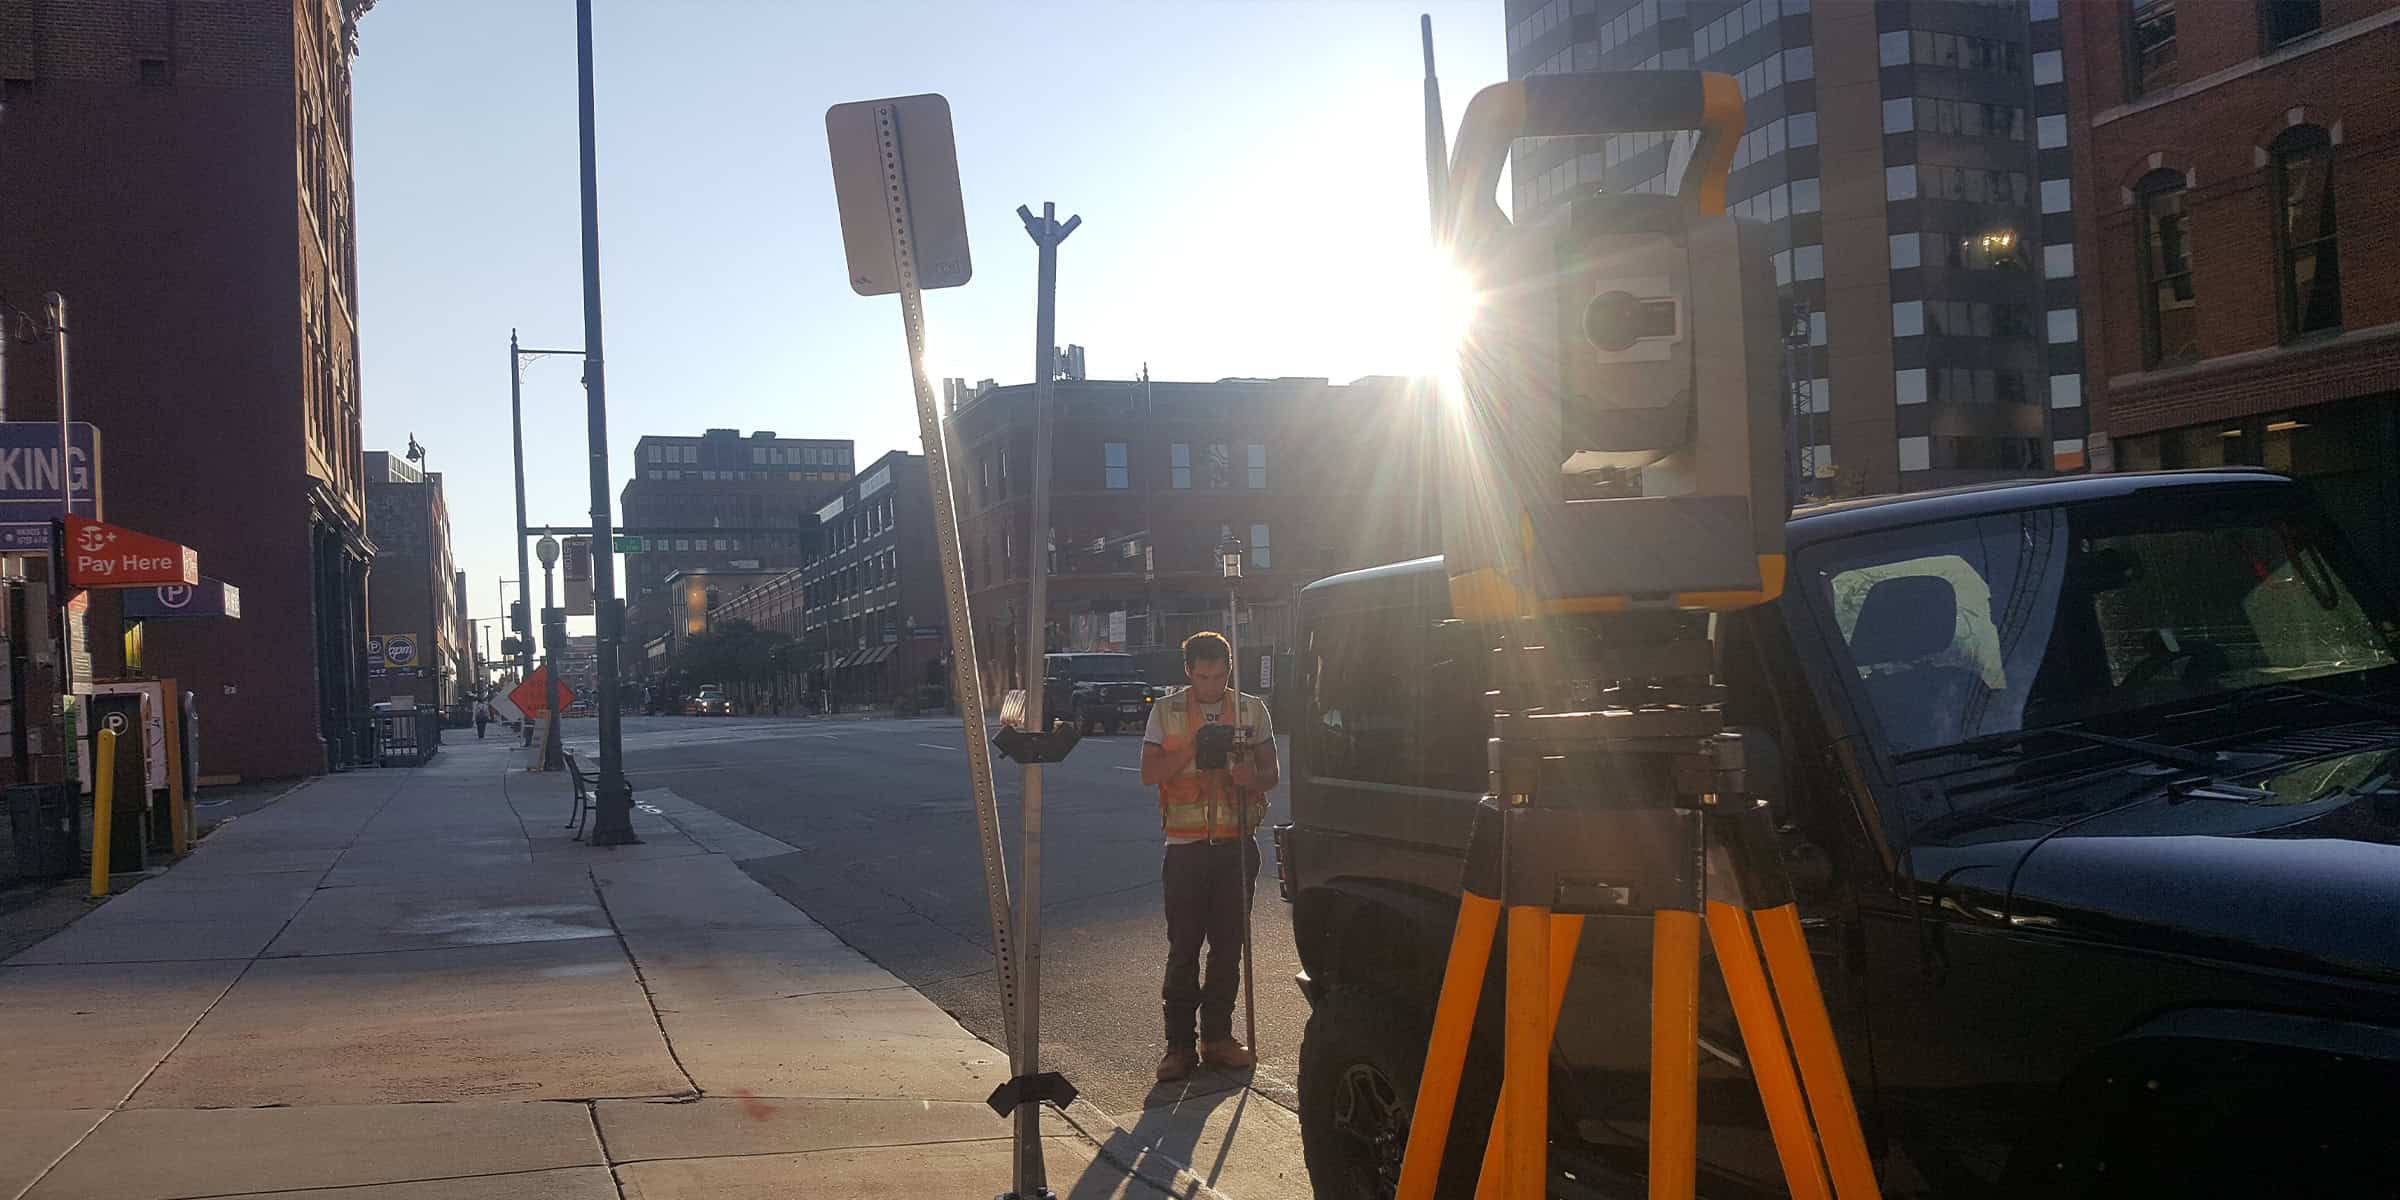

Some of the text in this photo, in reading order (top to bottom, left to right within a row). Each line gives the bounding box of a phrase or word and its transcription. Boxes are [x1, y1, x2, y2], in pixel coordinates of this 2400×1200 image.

[0, 446, 88, 490] KING
[78, 556, 116, 576] Pay
[122, 554, 173, 571] Here
